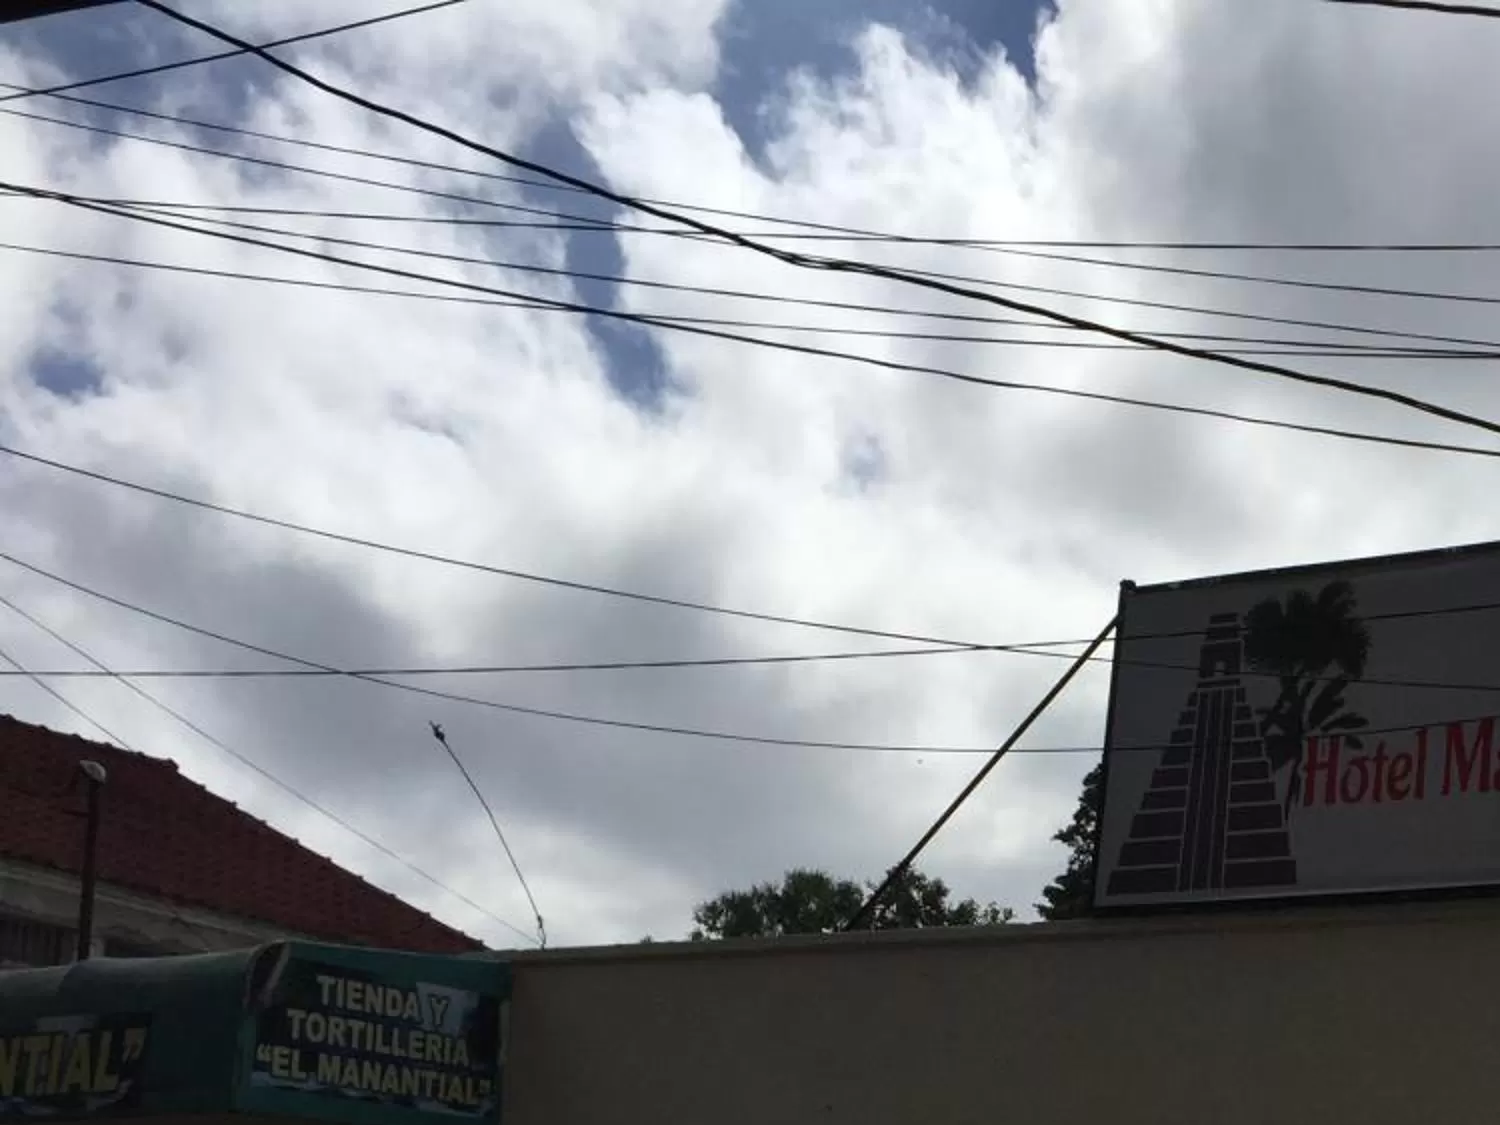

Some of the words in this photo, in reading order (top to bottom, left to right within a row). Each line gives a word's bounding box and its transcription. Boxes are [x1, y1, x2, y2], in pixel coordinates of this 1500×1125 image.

[1303, 726, 1428, 806] Hotel
[316, 974, 420, 1020] TIENDA
[430, 995, 449, 1026] Y
[286, 1008, 469, 1066] TORTILLERIA
